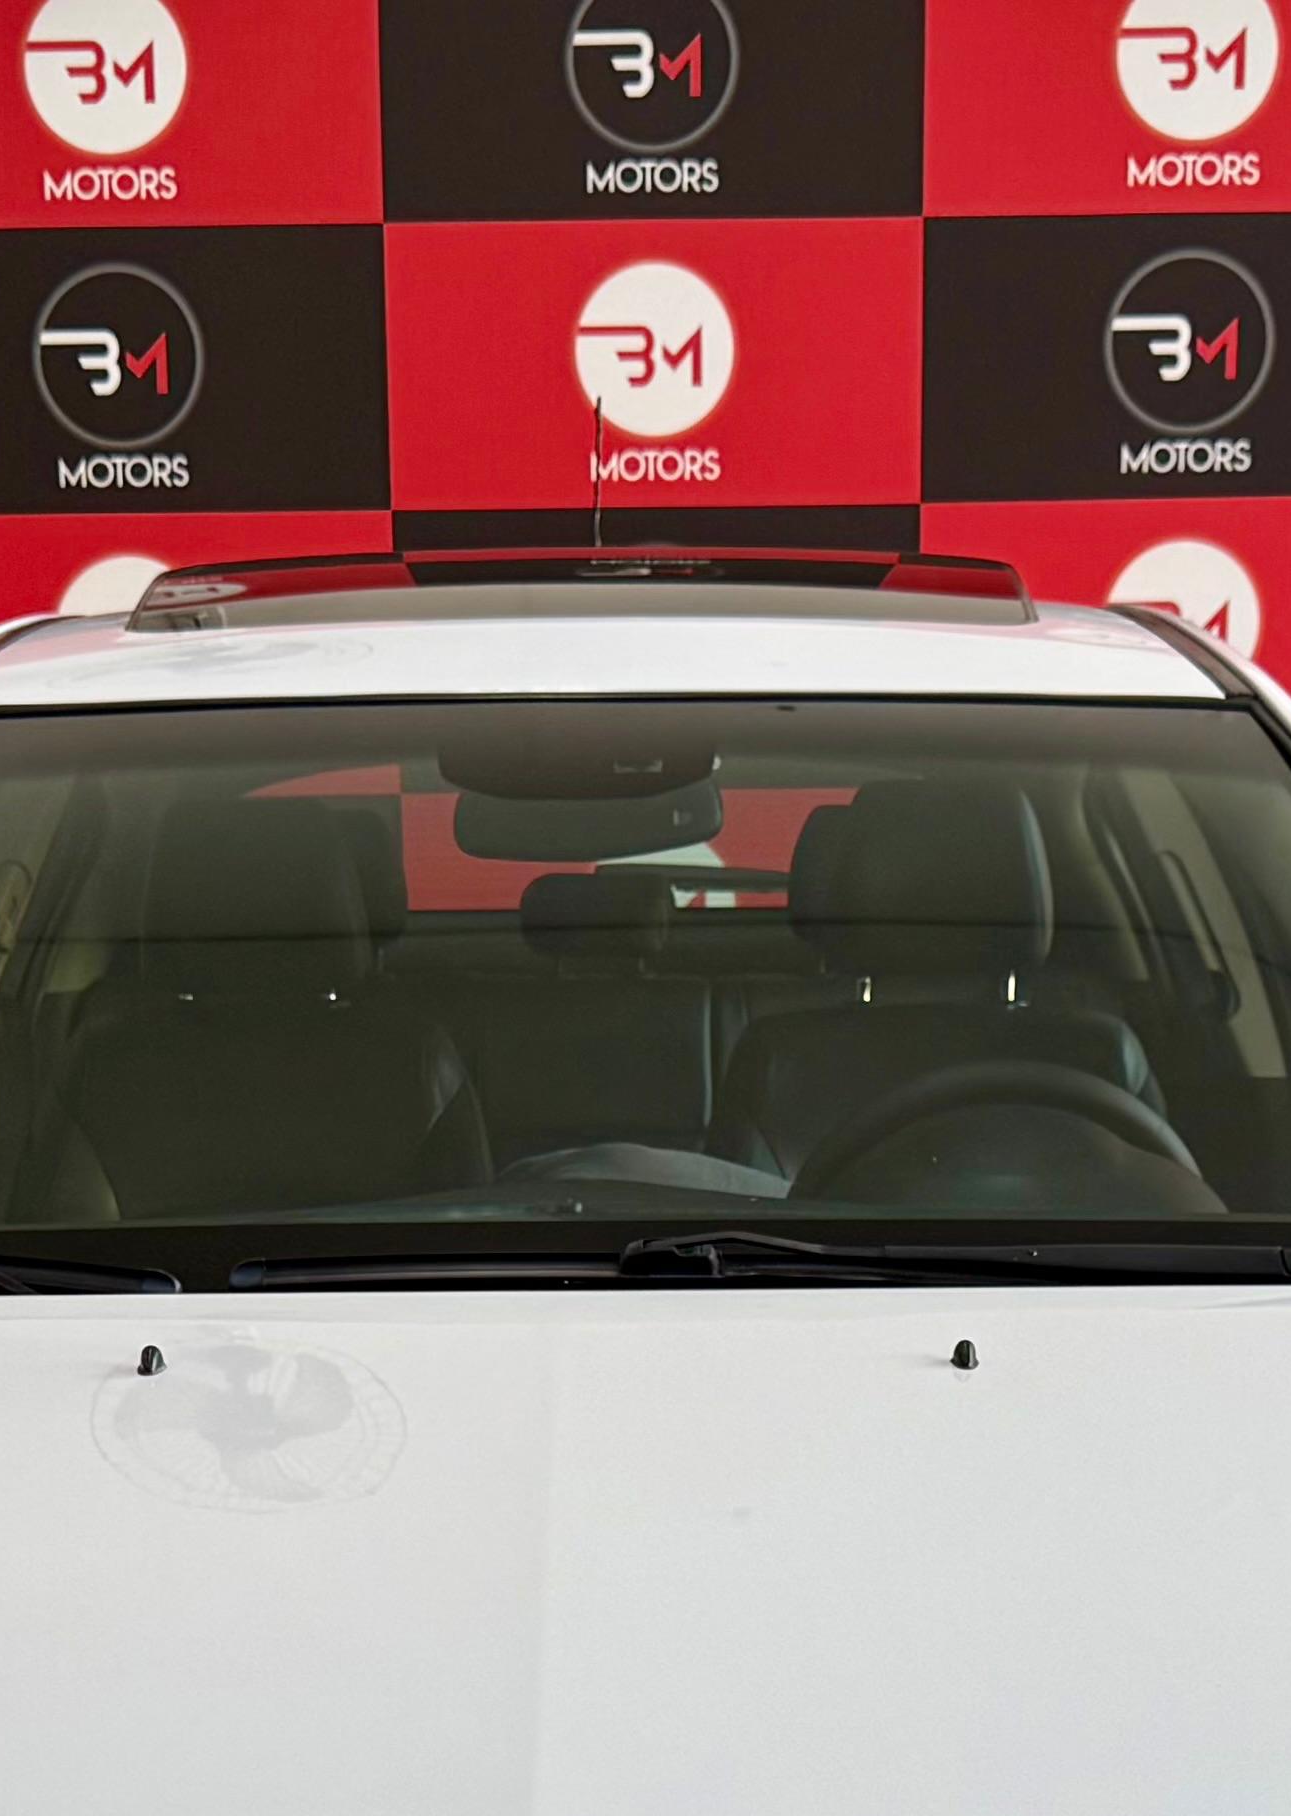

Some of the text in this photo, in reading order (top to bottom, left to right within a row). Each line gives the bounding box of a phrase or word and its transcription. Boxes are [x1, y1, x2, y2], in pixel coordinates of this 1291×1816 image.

[44, 167, 177, 200] MOTORS
[587, 160, 718, 193] MOTORS
[1128, 153, 1260, 186] MOTORS
[59, 456, 189, 488] MOTORS
[591, 449, 720, 481] MOTORS
[1121, 439, 1251, 473] MOTORS
